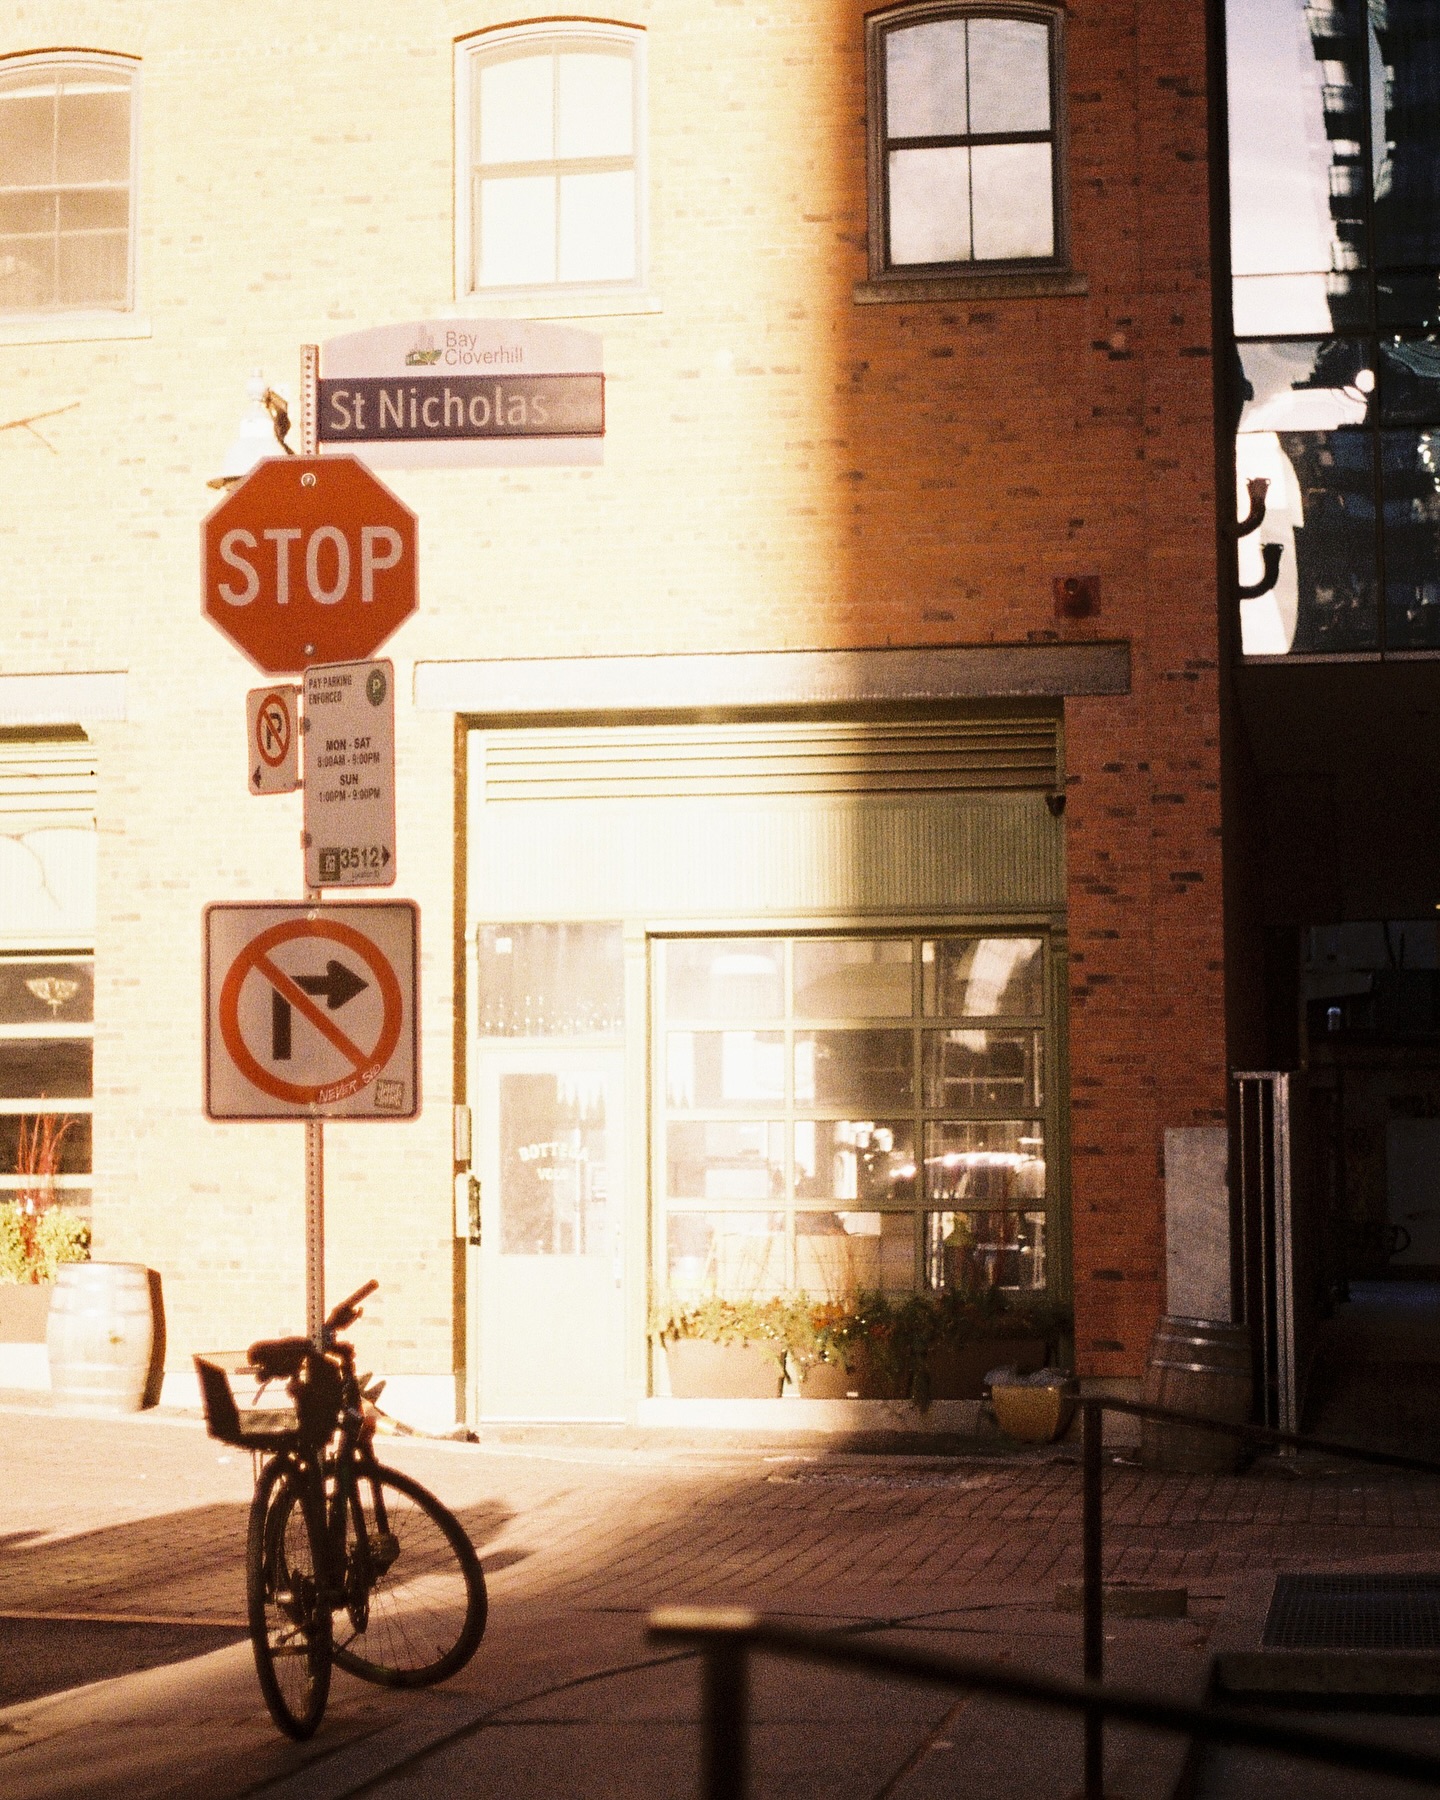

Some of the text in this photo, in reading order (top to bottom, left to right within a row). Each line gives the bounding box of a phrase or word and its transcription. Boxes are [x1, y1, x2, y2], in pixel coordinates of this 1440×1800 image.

[445, 331, 478, 351] Bay
[444, 346, 523, 366] Cloverhill
[330, 390, 365, 430] St
[379, 387, 549, 428] Nicholas
[218, 525, 403, 607] STOP
[309, 675, 352, 689] PAY PARKING
[309, 691, 342, 705] ENFORCED
[326, 739, 347, 751] MON
[354, 737, 371, 749] SAT
[340, 773, 359, 786] SUN
[341, 846, 379, 869] 3512
